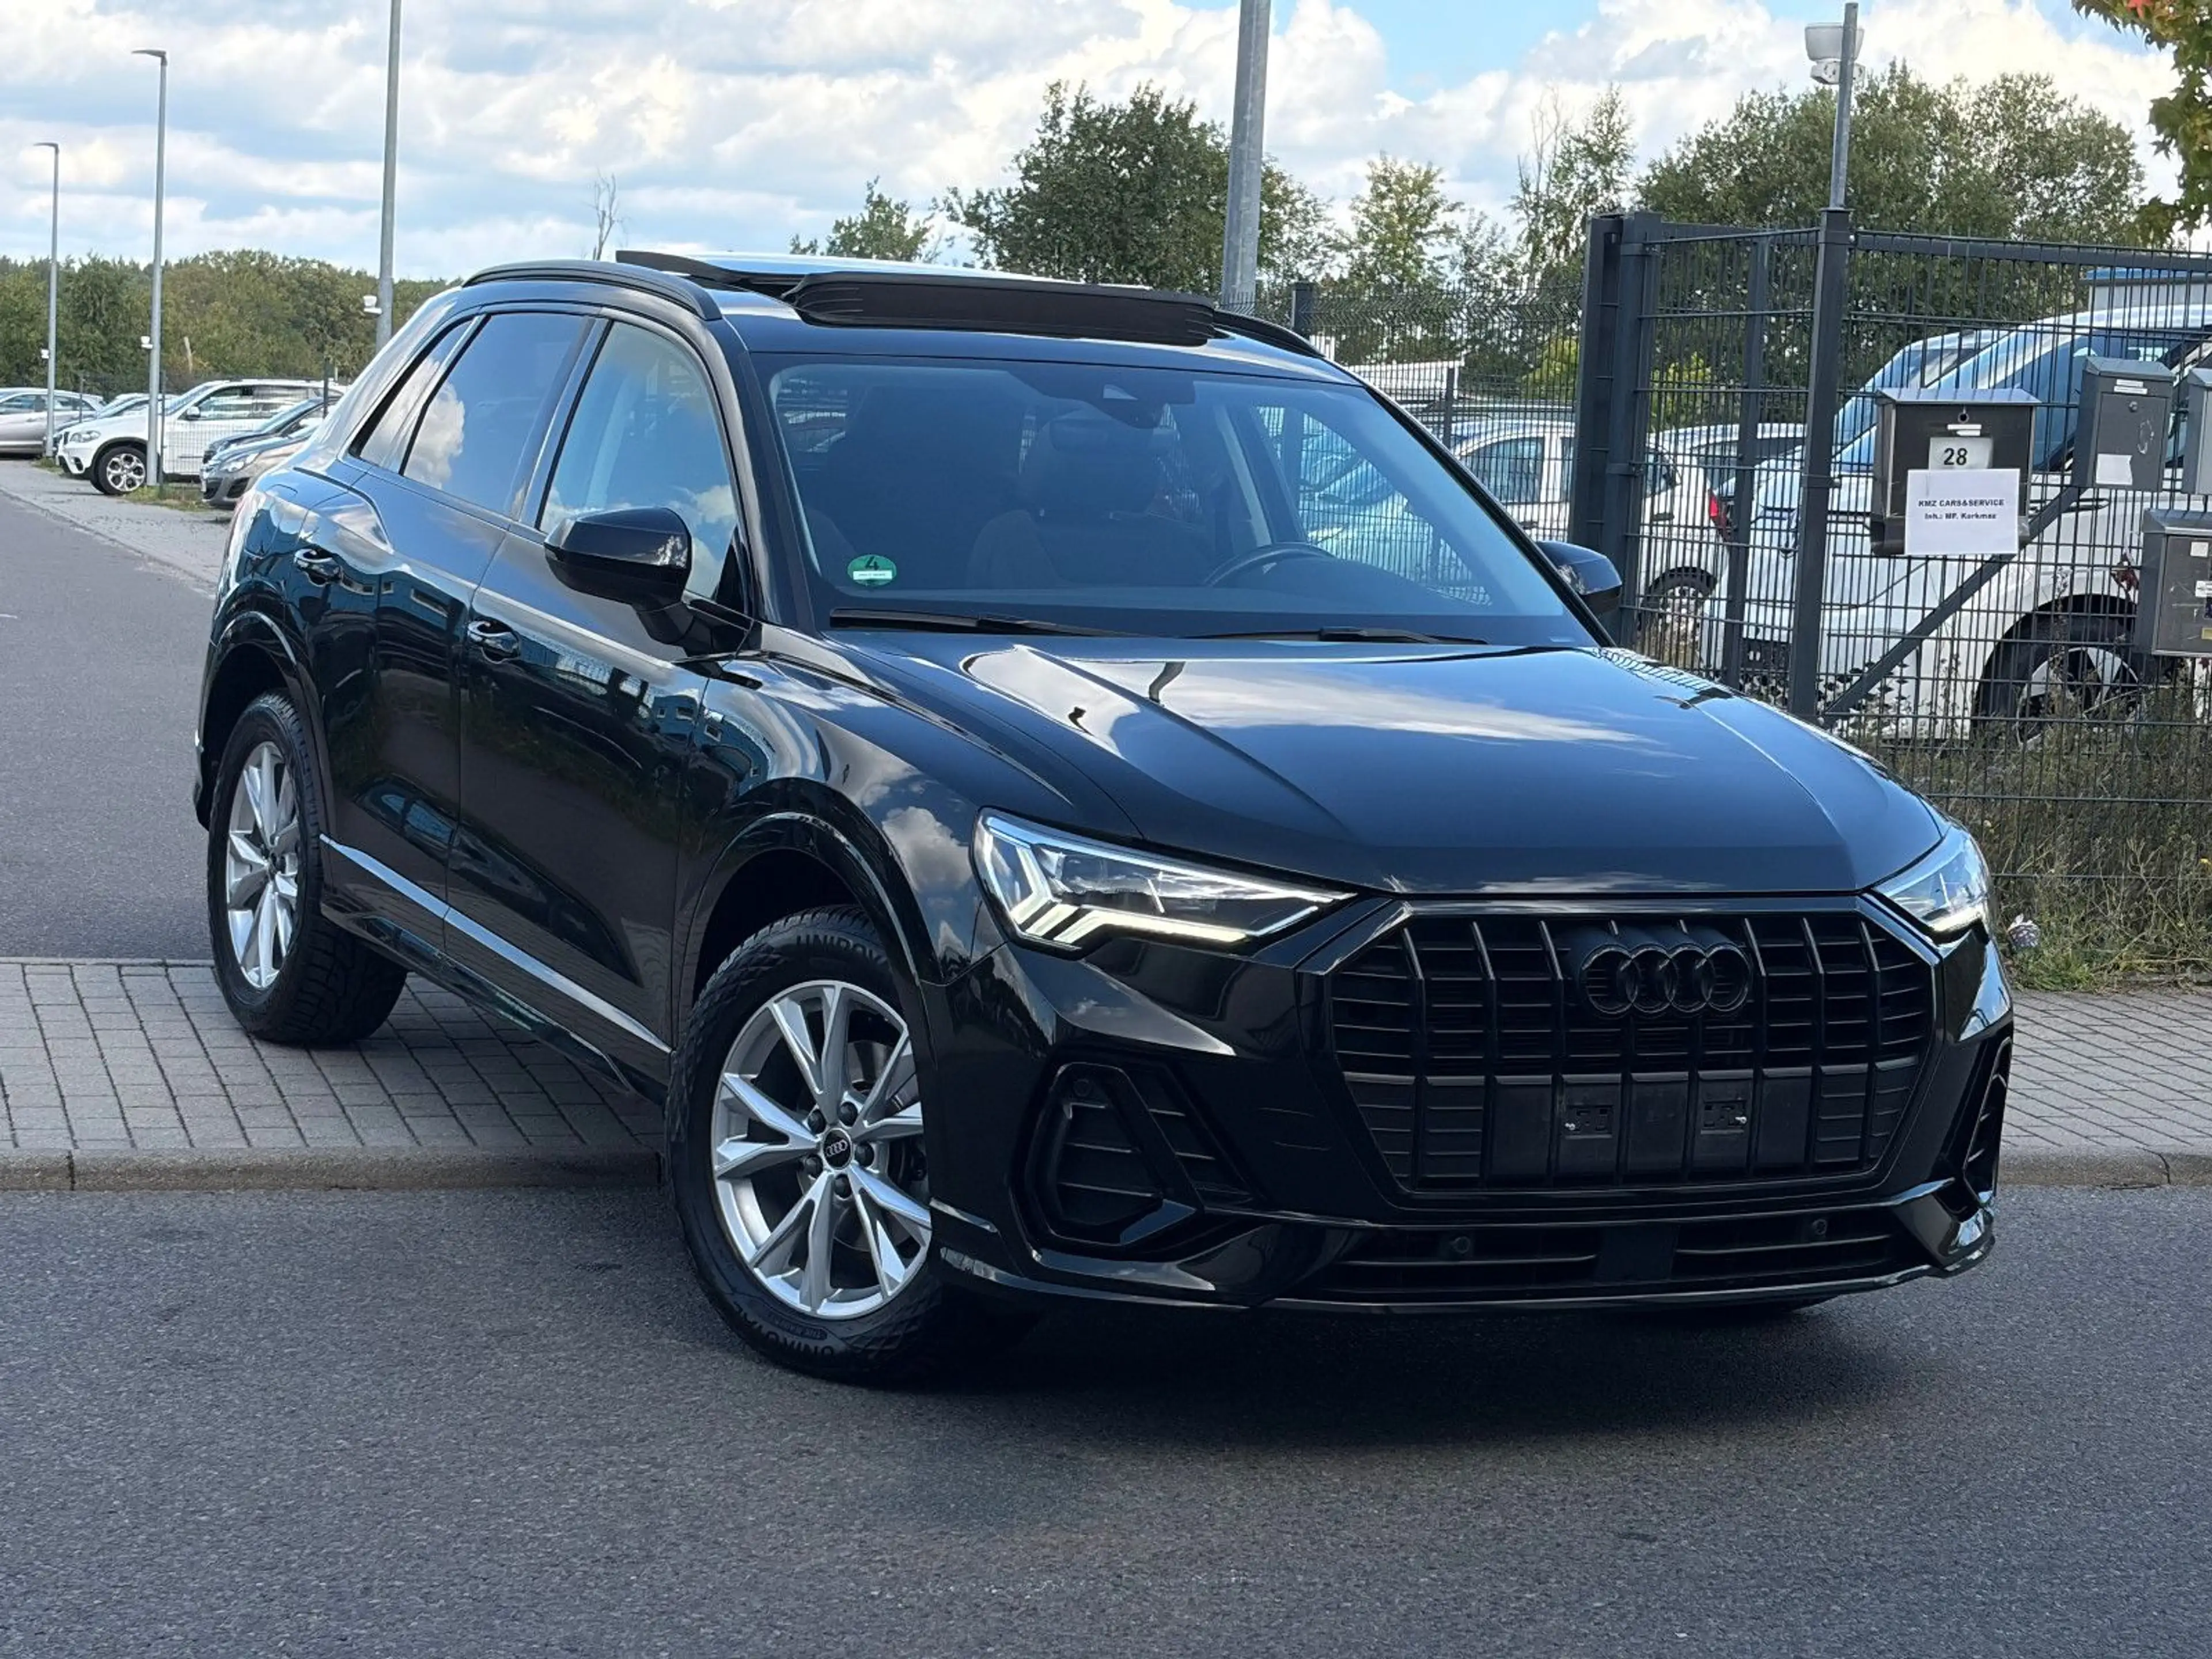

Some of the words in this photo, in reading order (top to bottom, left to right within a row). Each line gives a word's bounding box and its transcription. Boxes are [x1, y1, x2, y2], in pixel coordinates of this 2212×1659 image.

[1944, 448, 1968, 465] 28
[1939, 499, 2005, 507] CARS&SERVICE
[865, 556, 880, 570] 4
